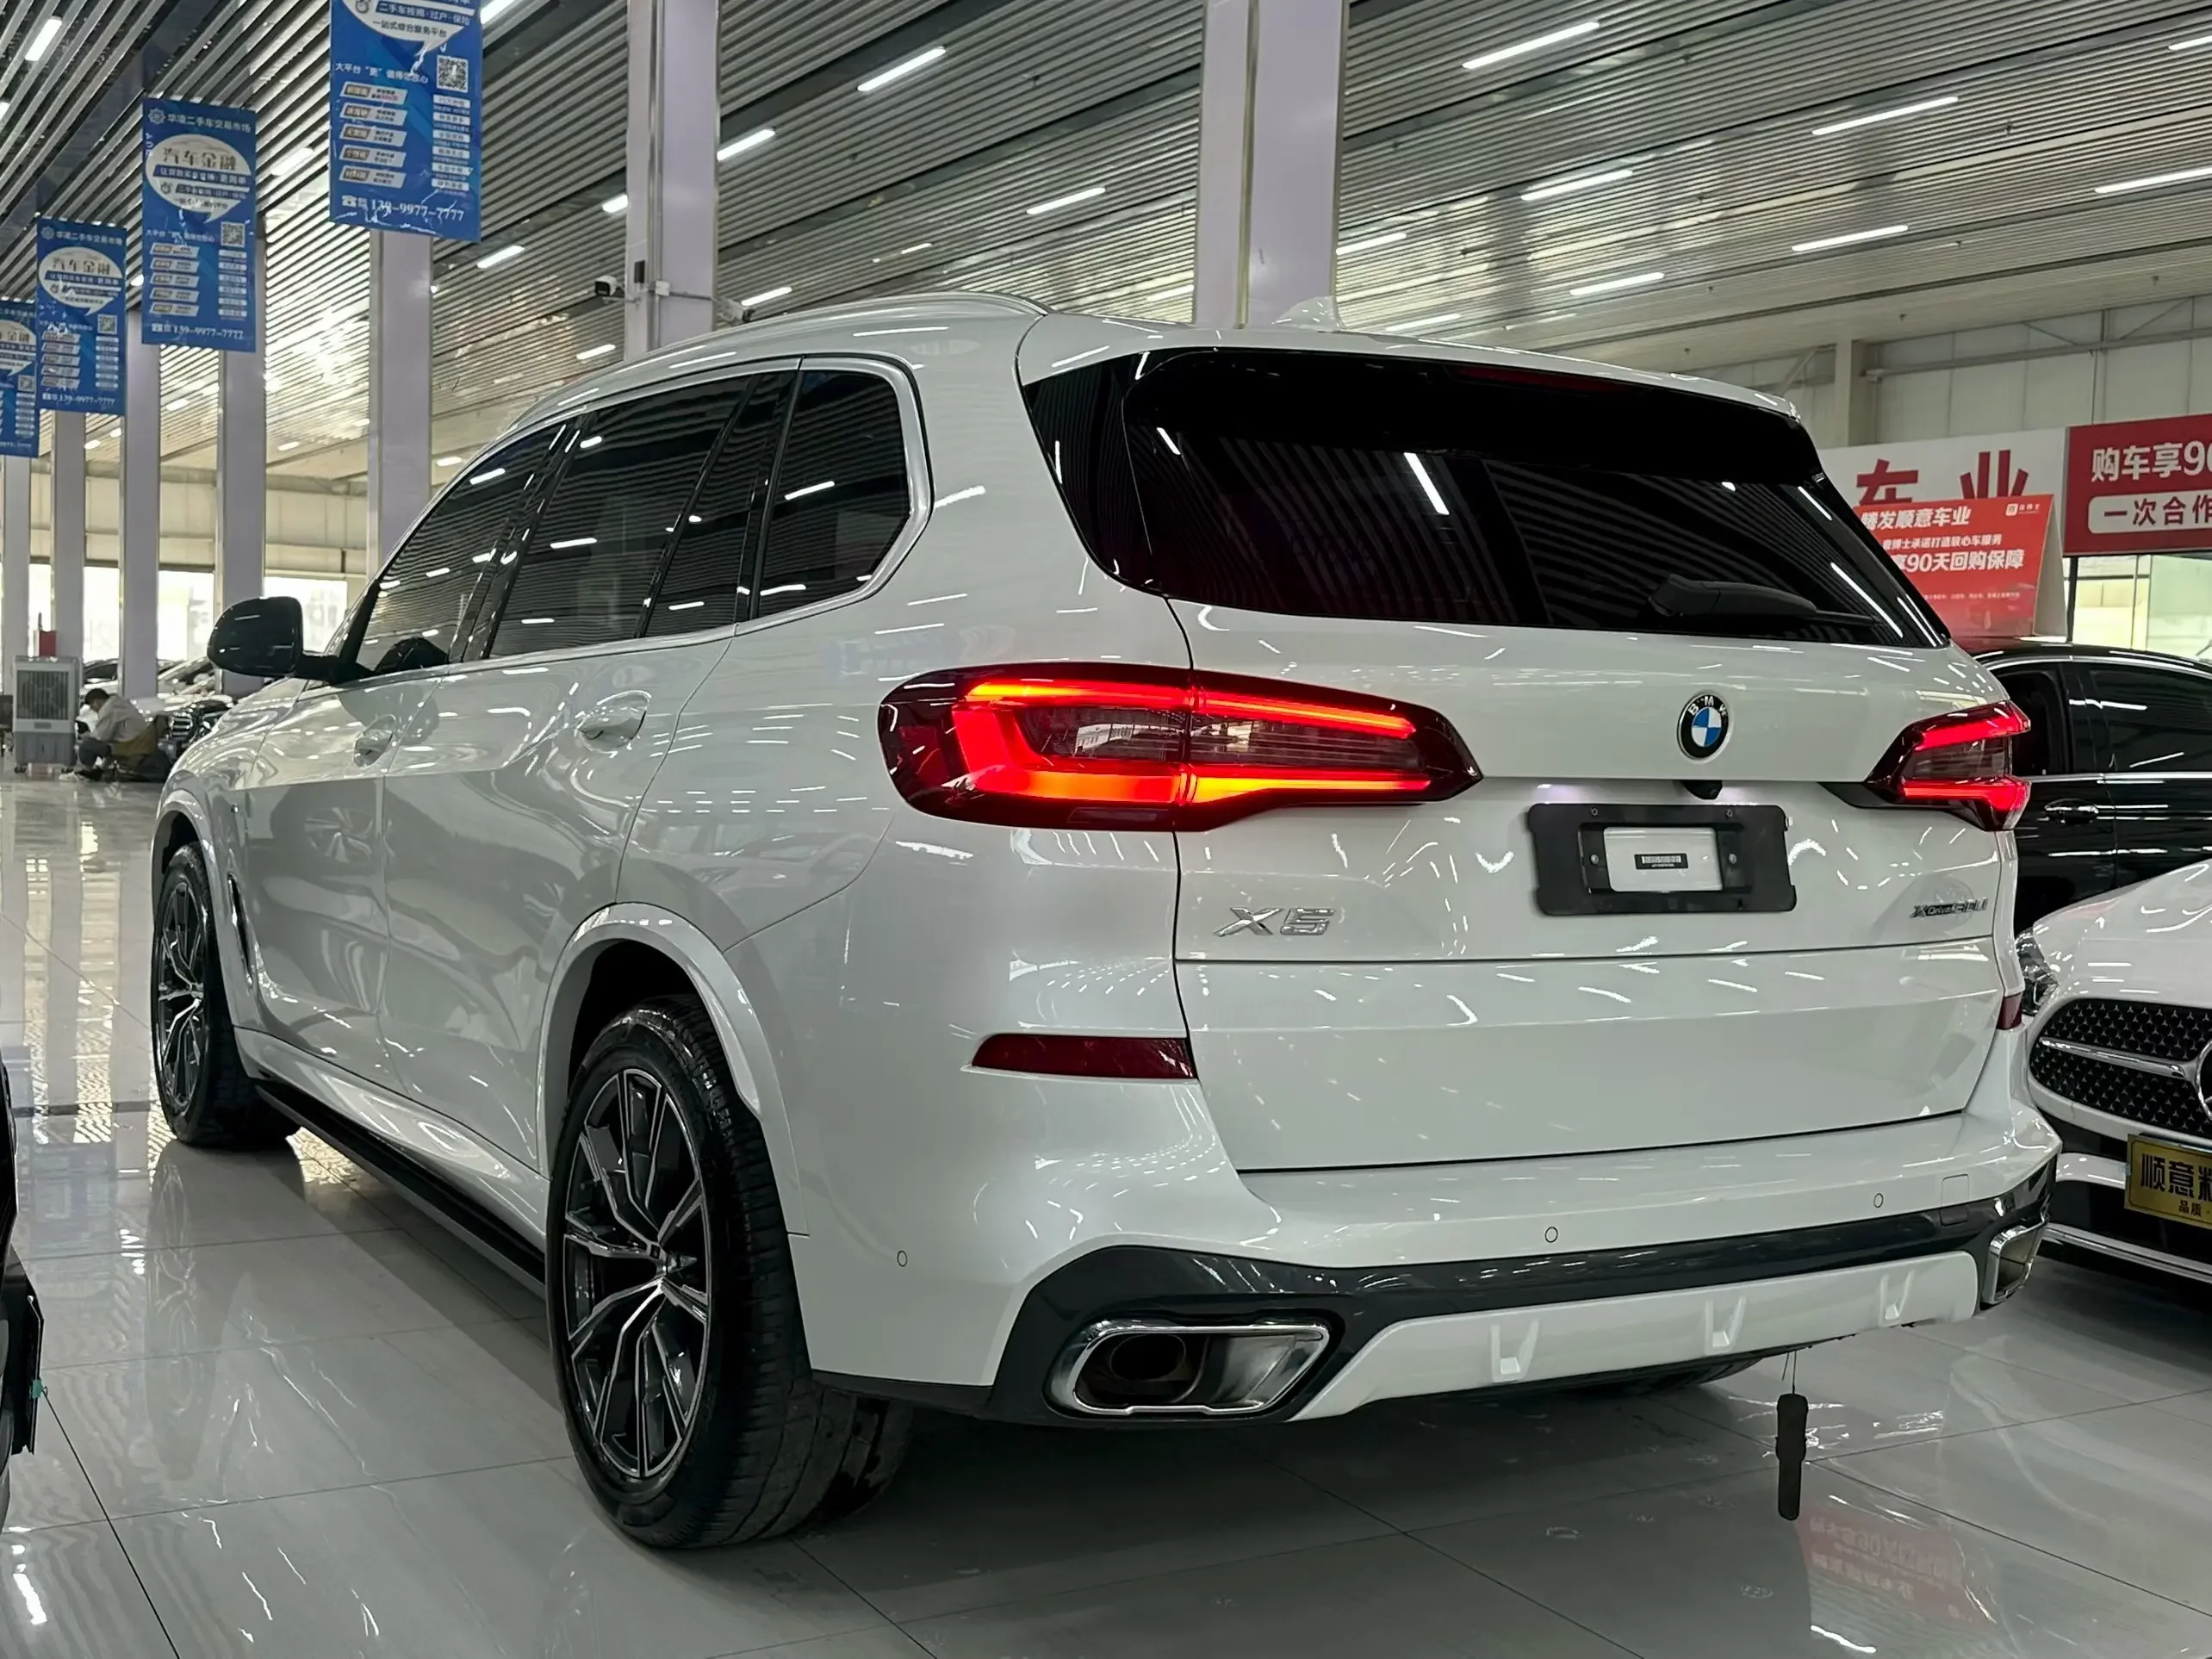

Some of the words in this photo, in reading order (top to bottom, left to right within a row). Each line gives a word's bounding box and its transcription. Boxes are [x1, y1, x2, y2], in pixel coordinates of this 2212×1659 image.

[163, 147, 236, 171] 汽车金融
[2091, 440, 2212, 482] 购车享9
[1213, 907, 1335, 937] X5
